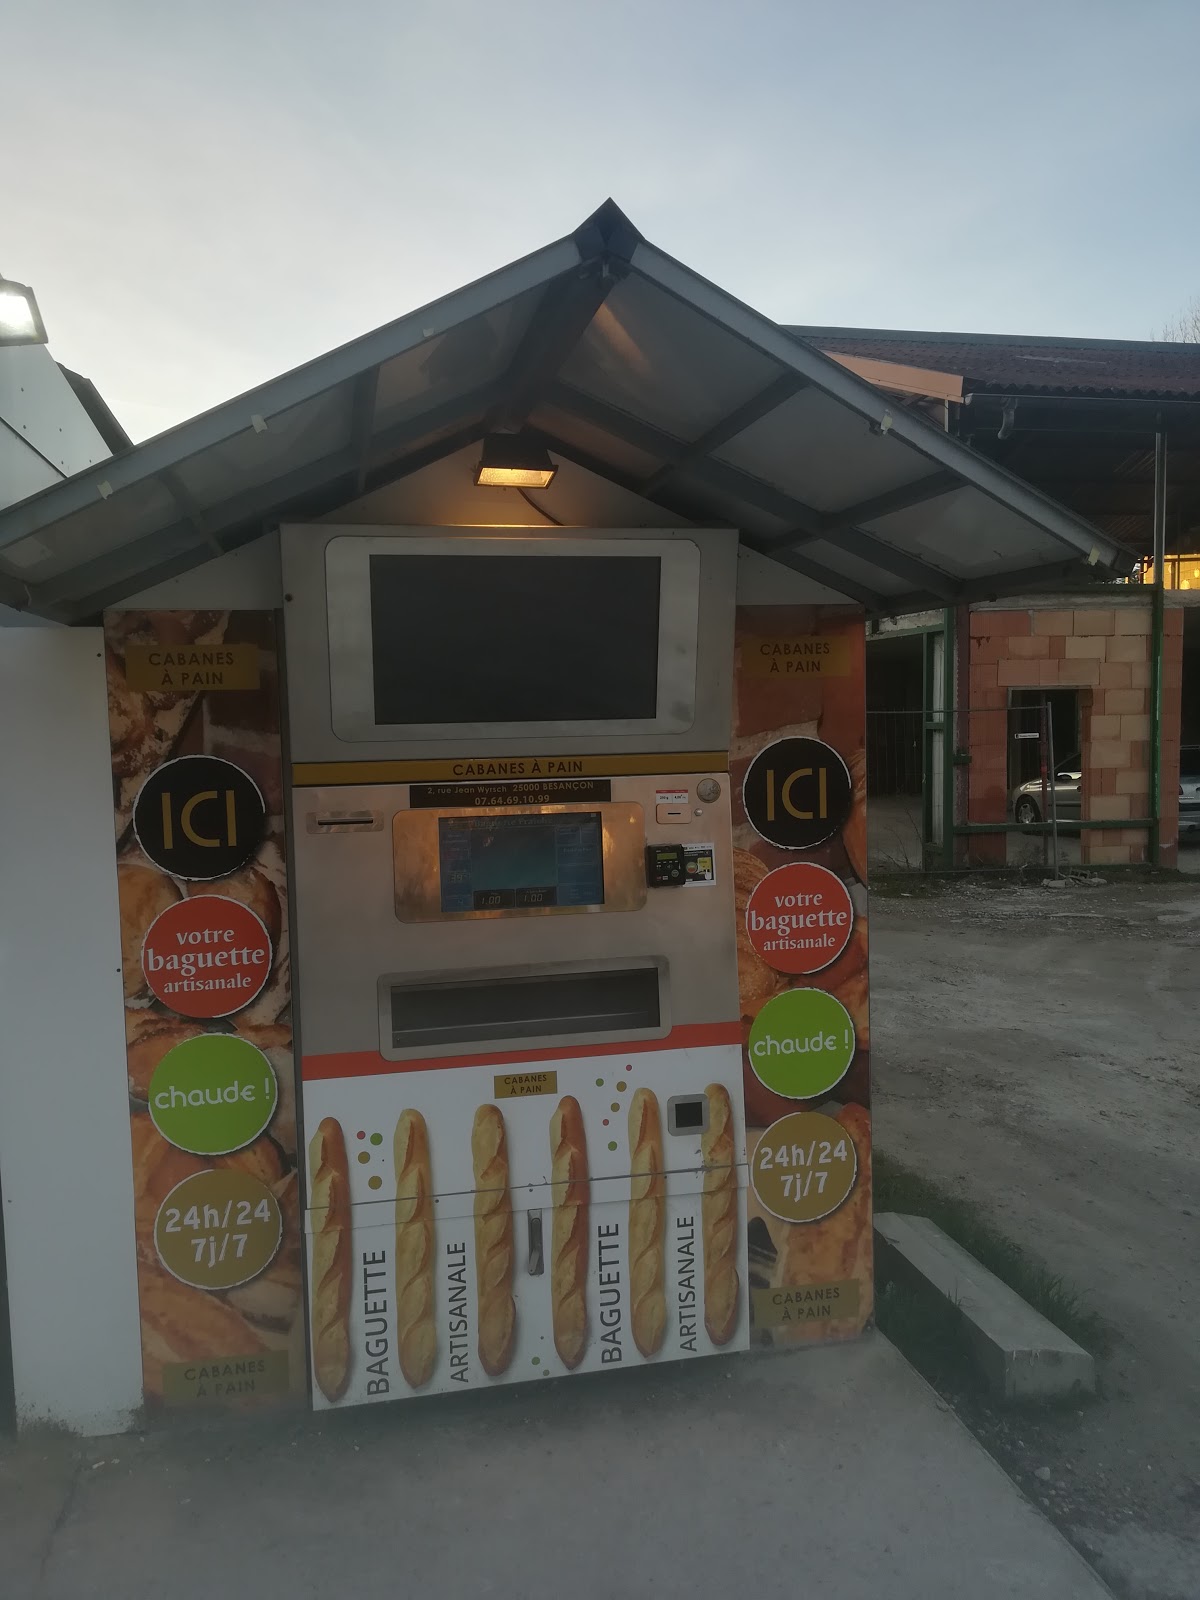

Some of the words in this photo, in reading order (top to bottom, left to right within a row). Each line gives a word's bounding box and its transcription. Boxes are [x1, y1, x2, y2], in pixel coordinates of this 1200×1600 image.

[148, 652, 235, 666] CABANES
[760, 642, 830, 656] CABANES
[769, 658, 780, 673] À
[786, 660, 821, 673] PAIN
[161, 669, 173, 686] À
[181, 672, 224, 685] PAIN
[452, 762, 525, 776] CABANES
[531, 759, 542, 774] À
[548, 761, 583, 774] PAIN
[427, 787, 435, 795] 2,
[454, 786, 475, 794] Jean
[477, 785, 507, 795] Wyrsch
[512, 783, 540, 792] 25000
[542, 781, 595, 791] BESANÇON
[766, 767, 828, 821] ICI
[474, 794, 550, 806] 07.64.69.10.99
[161, 790, 237, 850] ICI
[774, 892, 823, 908] votre
[750, 909, 848, 937] baguette
[175, 928, 235, 946] votre
[763, 933, 836, 951] artisanale
[147, 948, 265, 977] baguette
[163, 973, 252, 993] artisanale
[753, 1030, 837, 1057] chaude
[844, 1029, 849, 1050] !
[504, 1074, 547, 1085] CABANES
[154, 1080, 256, 1110] chaude
[264, 1077, 270, 1100] !
[510, 1085, 517, 1095] À
[520, 1085, 542, 1094] PAIN
[759, 1139, 848, 1170] 24h/24
[780, 1171, 828, 1203] 7j/7
[165, 1198, 271, 1233] 24h/24
[190, 1233, 248, 1268] 7j/7
[597, 1223, 623, 1364] BAGUETTE
[676, 1216, 698, 1352] ARTISANALE
[772, 1287, 840, 1306] CABANES
[446, 1242, 469, 1383] ARTISANALE
[782, 1306, 792, 1321] À
[797, 1305, 831, 1319] PAIN
[362, 1250, 390, 1396] BAGUETTE
[183, 1360, 265, 1381] CABANES
[215, 1379, 256, 1396] PAIN
